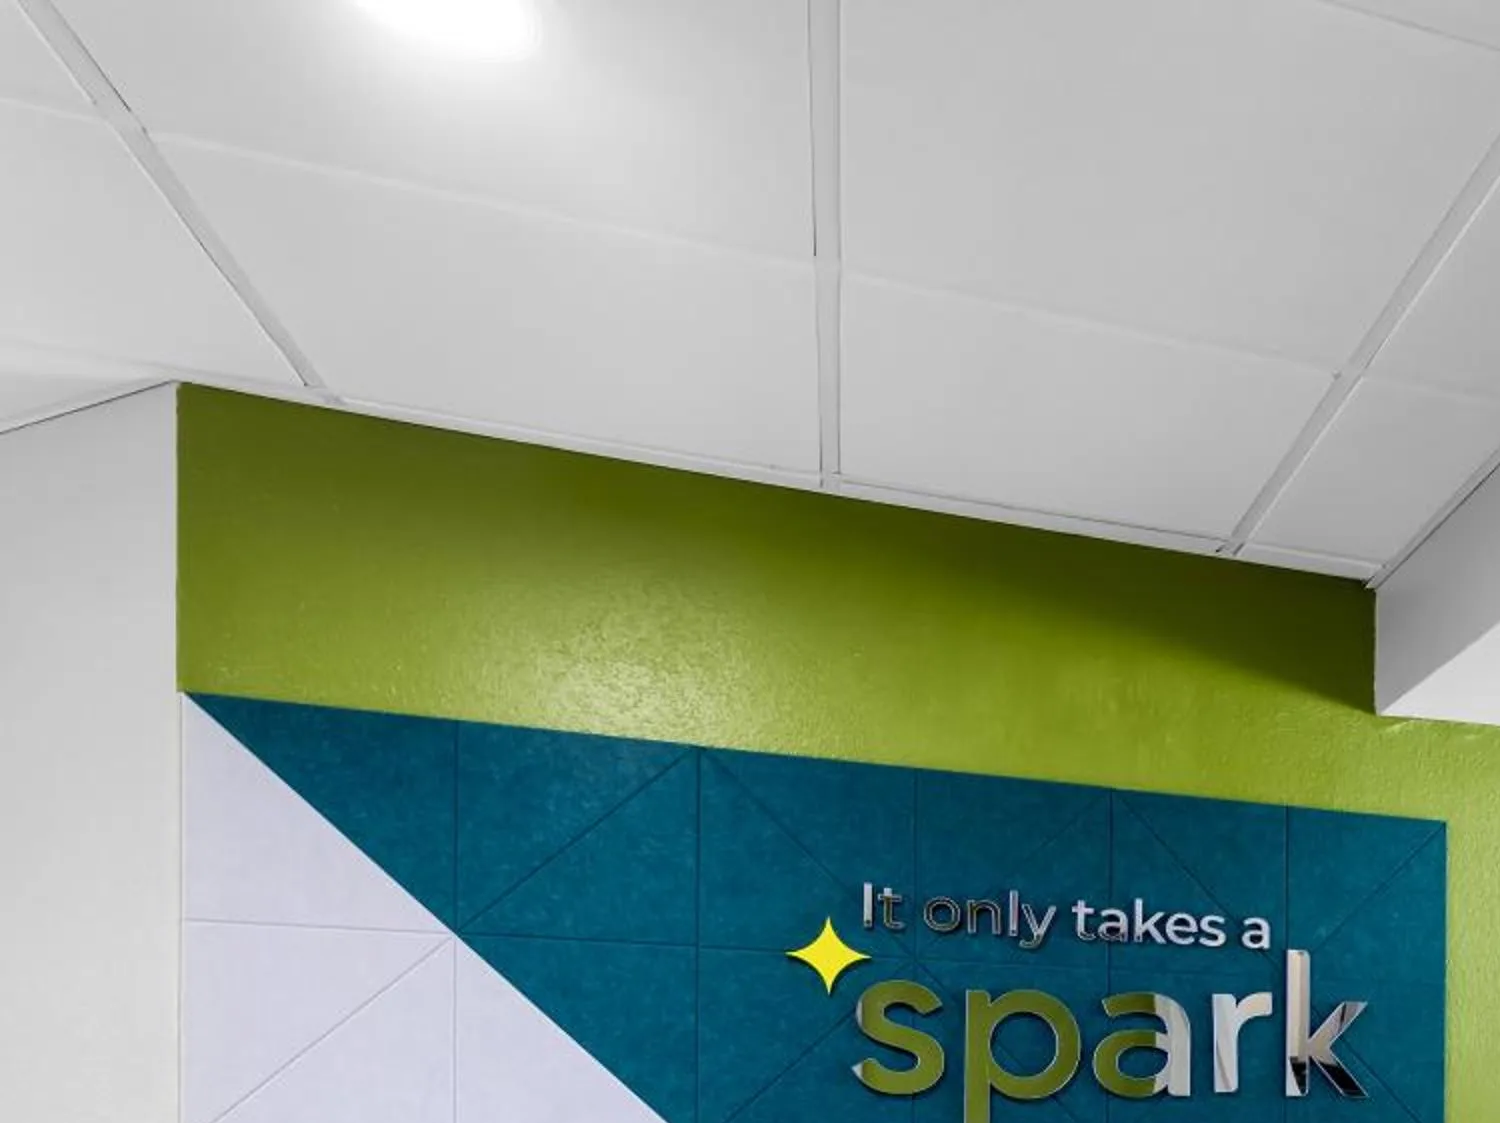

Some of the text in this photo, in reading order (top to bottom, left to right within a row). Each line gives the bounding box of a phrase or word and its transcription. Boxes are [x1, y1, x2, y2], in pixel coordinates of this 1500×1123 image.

[863, 882, 1271, 949] It only takes a
